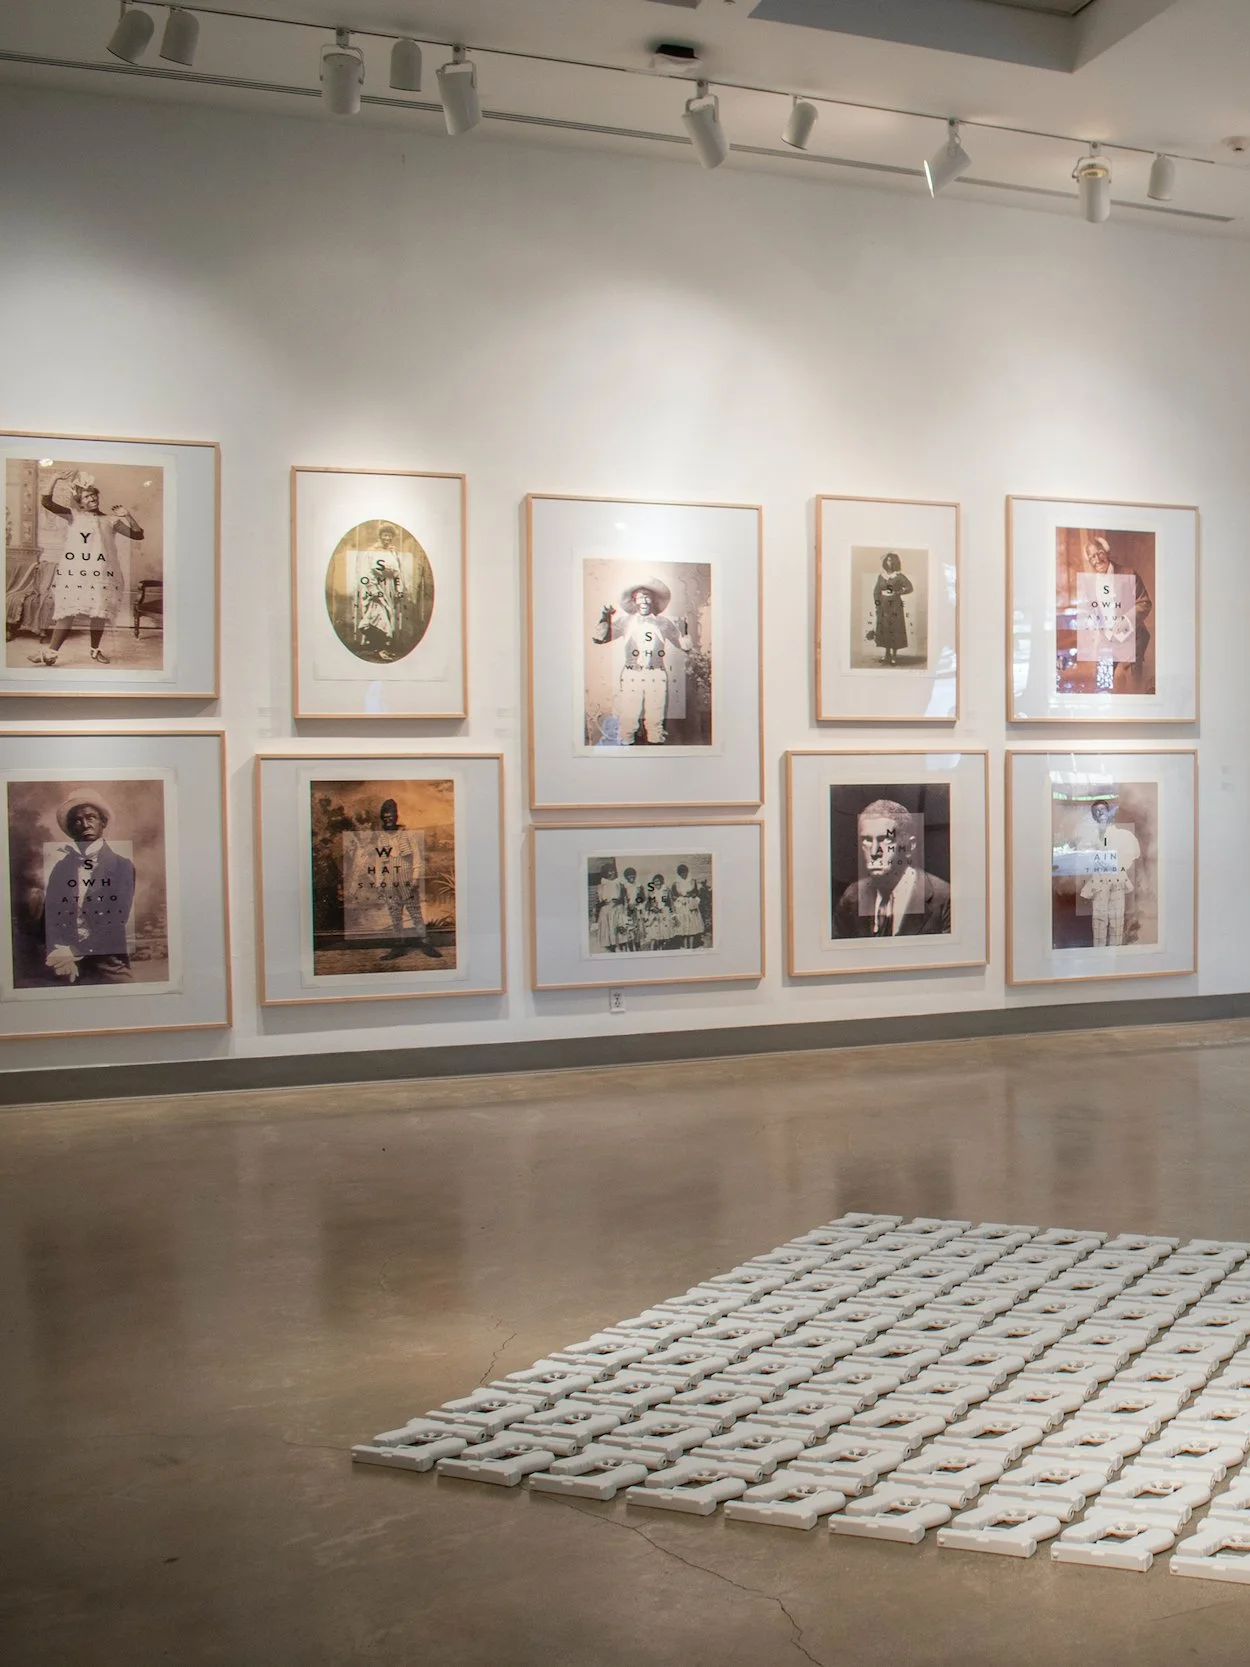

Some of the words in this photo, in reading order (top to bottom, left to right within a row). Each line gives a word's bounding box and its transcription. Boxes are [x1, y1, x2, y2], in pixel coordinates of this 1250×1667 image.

[80, 532, 92, 544] Y
[376, 559, 386, 571] S
[1103, 585, 1110, 595] S
[645, 632, 653, 642] S
[375, 847, 393, 858] W
[84, 859, 93, 870] S
